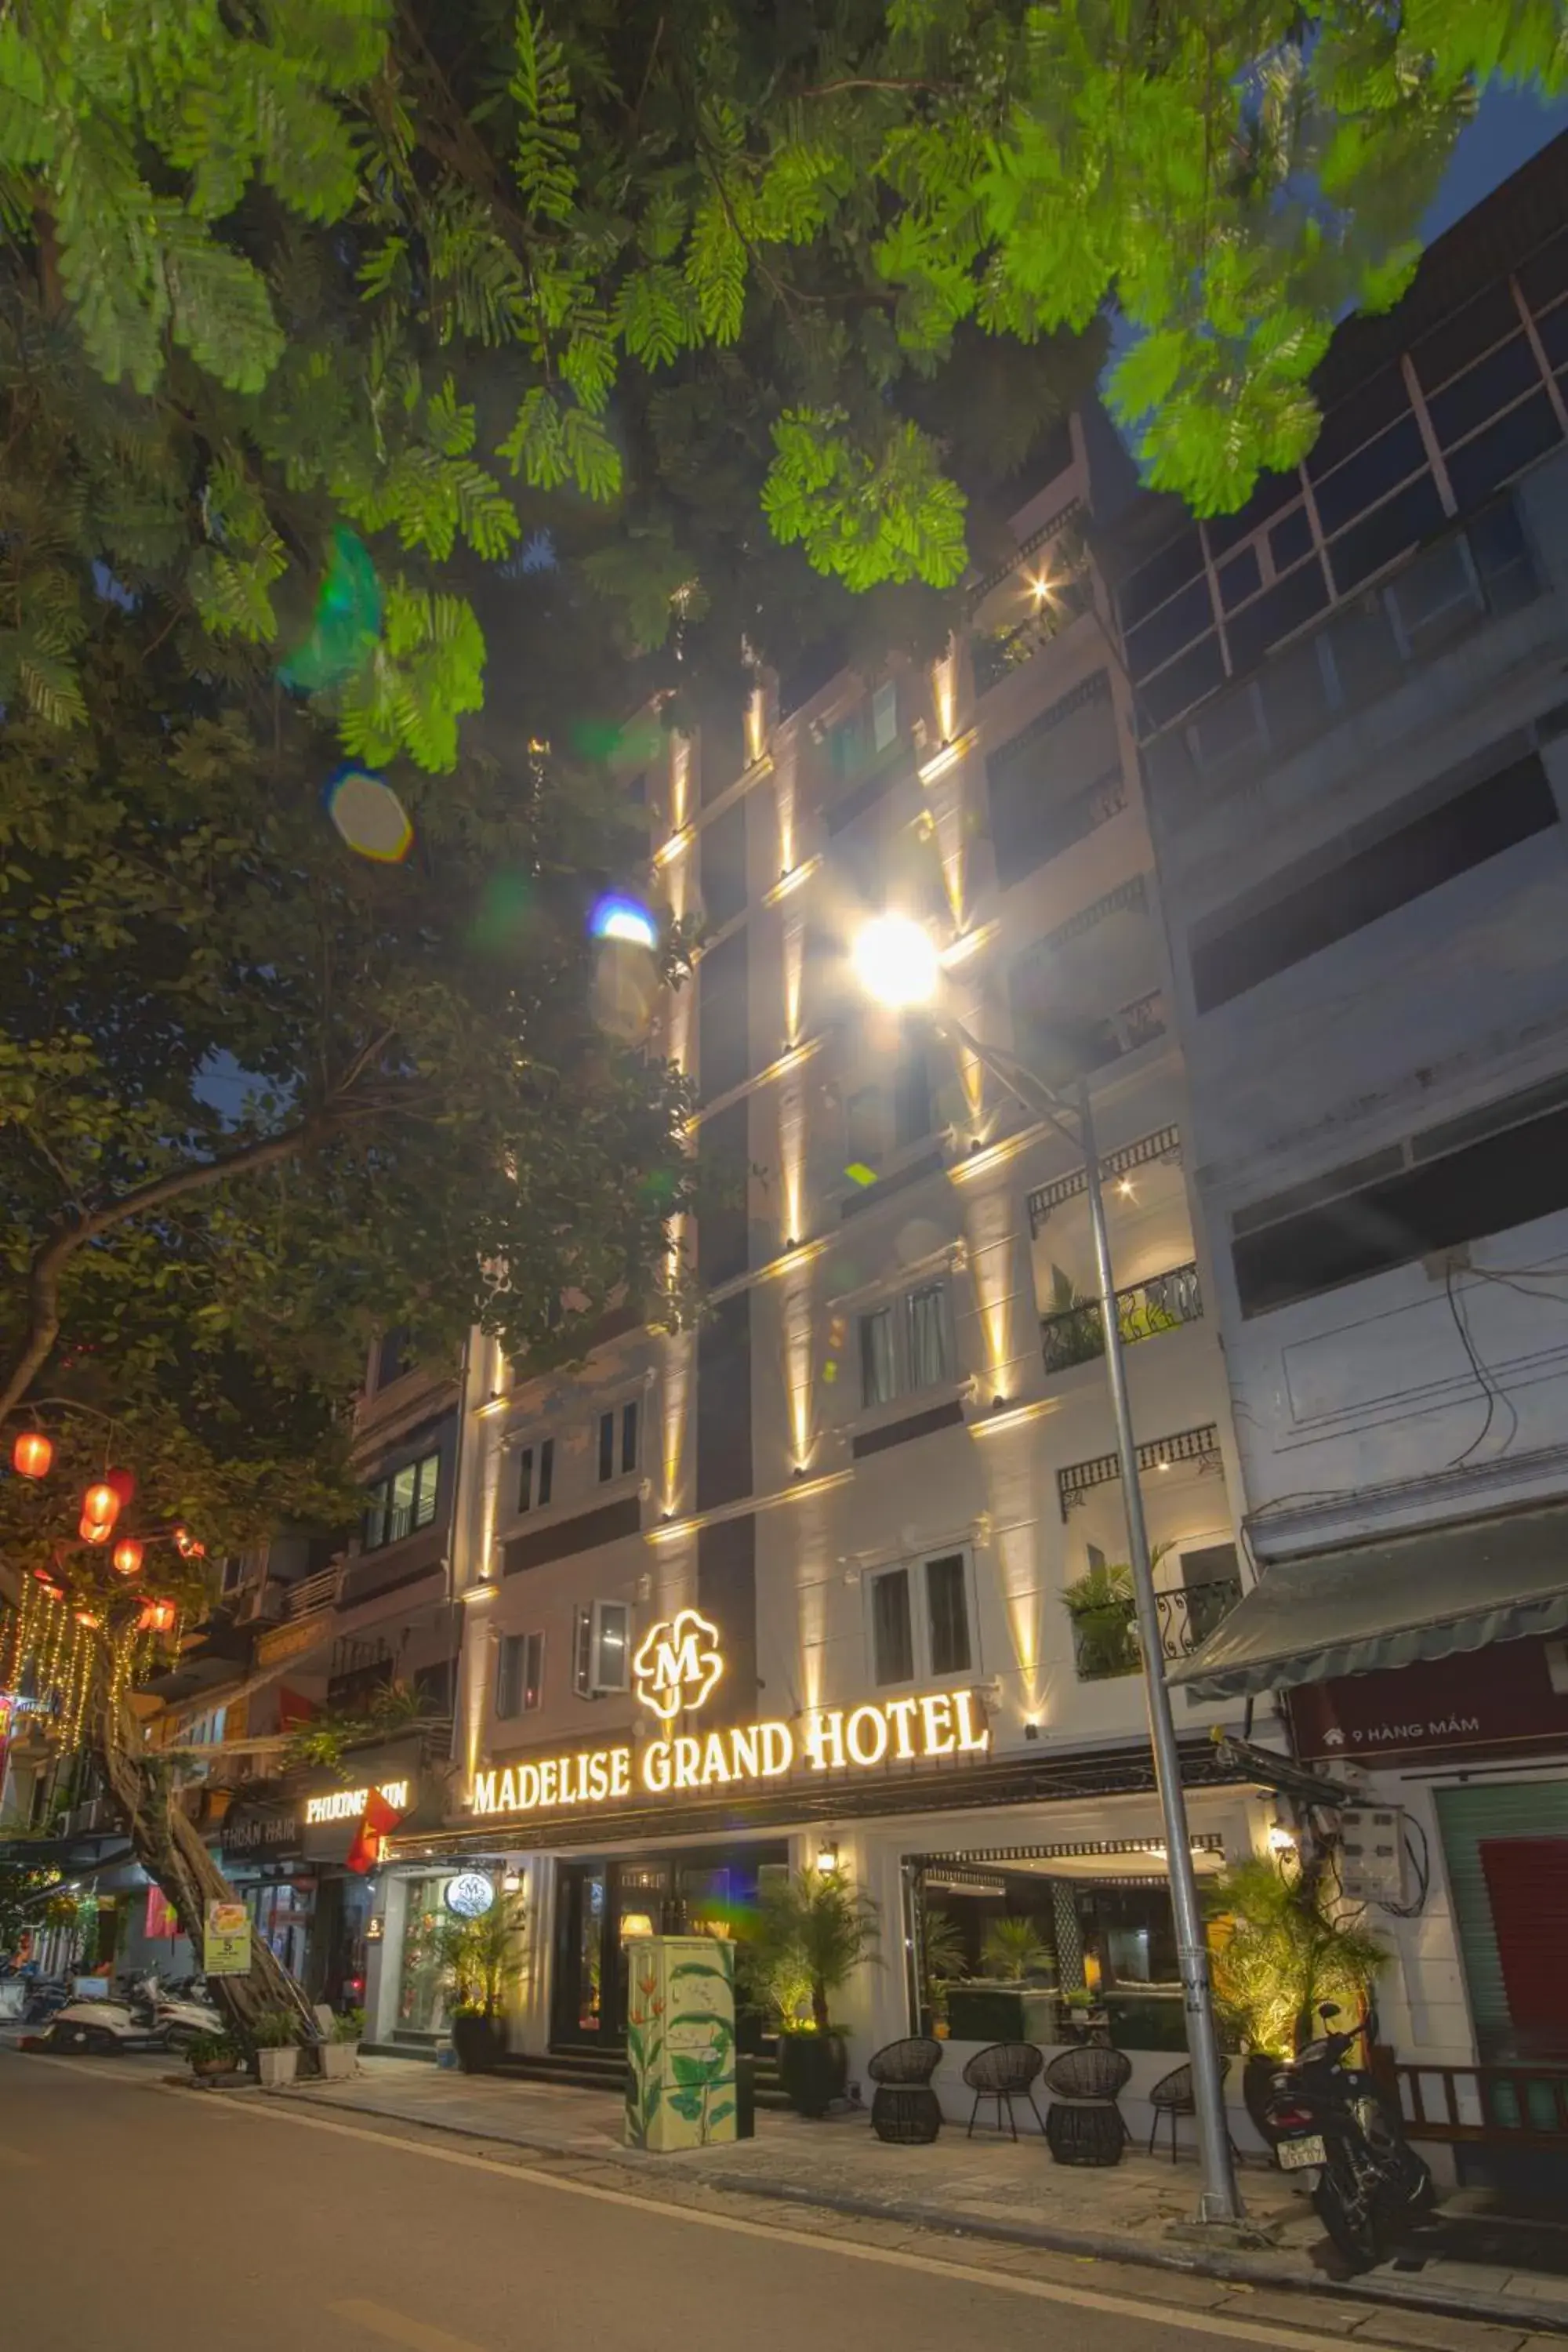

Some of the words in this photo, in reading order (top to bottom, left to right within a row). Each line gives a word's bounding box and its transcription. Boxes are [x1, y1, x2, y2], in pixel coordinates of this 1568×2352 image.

[652, 1633, 704, 1690] M
[1352, 1730, 1363, 1743] 9
[1367, 1722, 1424, 1742] HÀNG
[1428, 1712, 1479, 1735] MẮM
[472, 1748, 630, 1815] MADELISE
[643, 1722, 793, 1791] GRAND
[808, 1690, 989, 1769] HOTEL
[265, 1817, 296, 1842] HAIR
